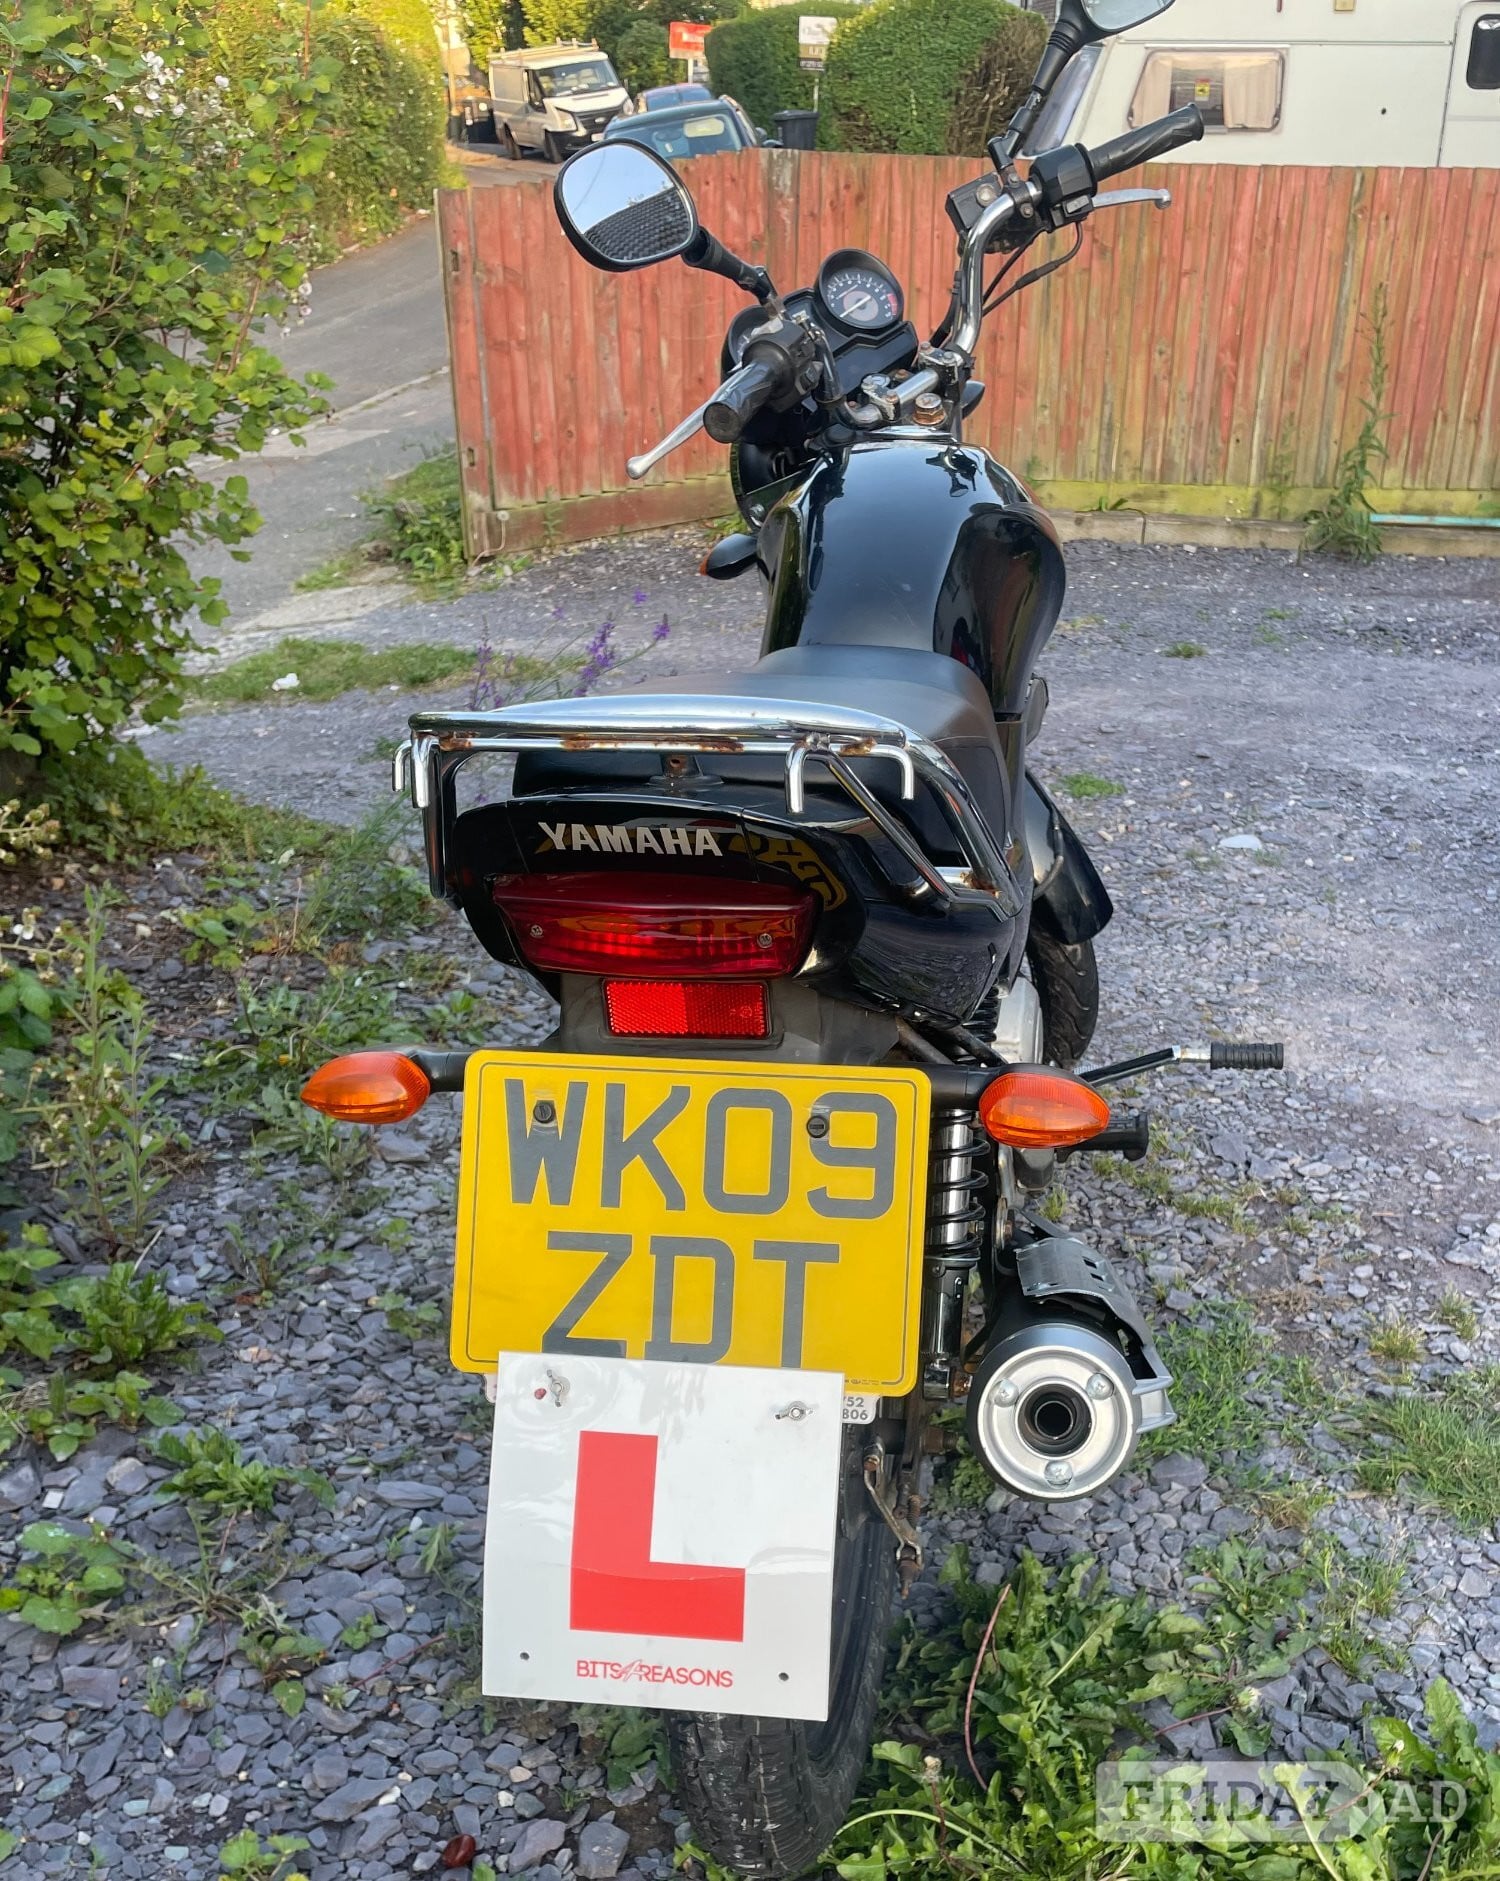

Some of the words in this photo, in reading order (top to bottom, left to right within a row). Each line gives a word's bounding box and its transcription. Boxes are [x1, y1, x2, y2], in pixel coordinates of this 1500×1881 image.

[538, 822, 723, 857] YAMAHA
[504, 1079, 896, 1219] WK09
[542, 1231, 840, 1368] ZDT
[570, 1431, 746, 1641] L
